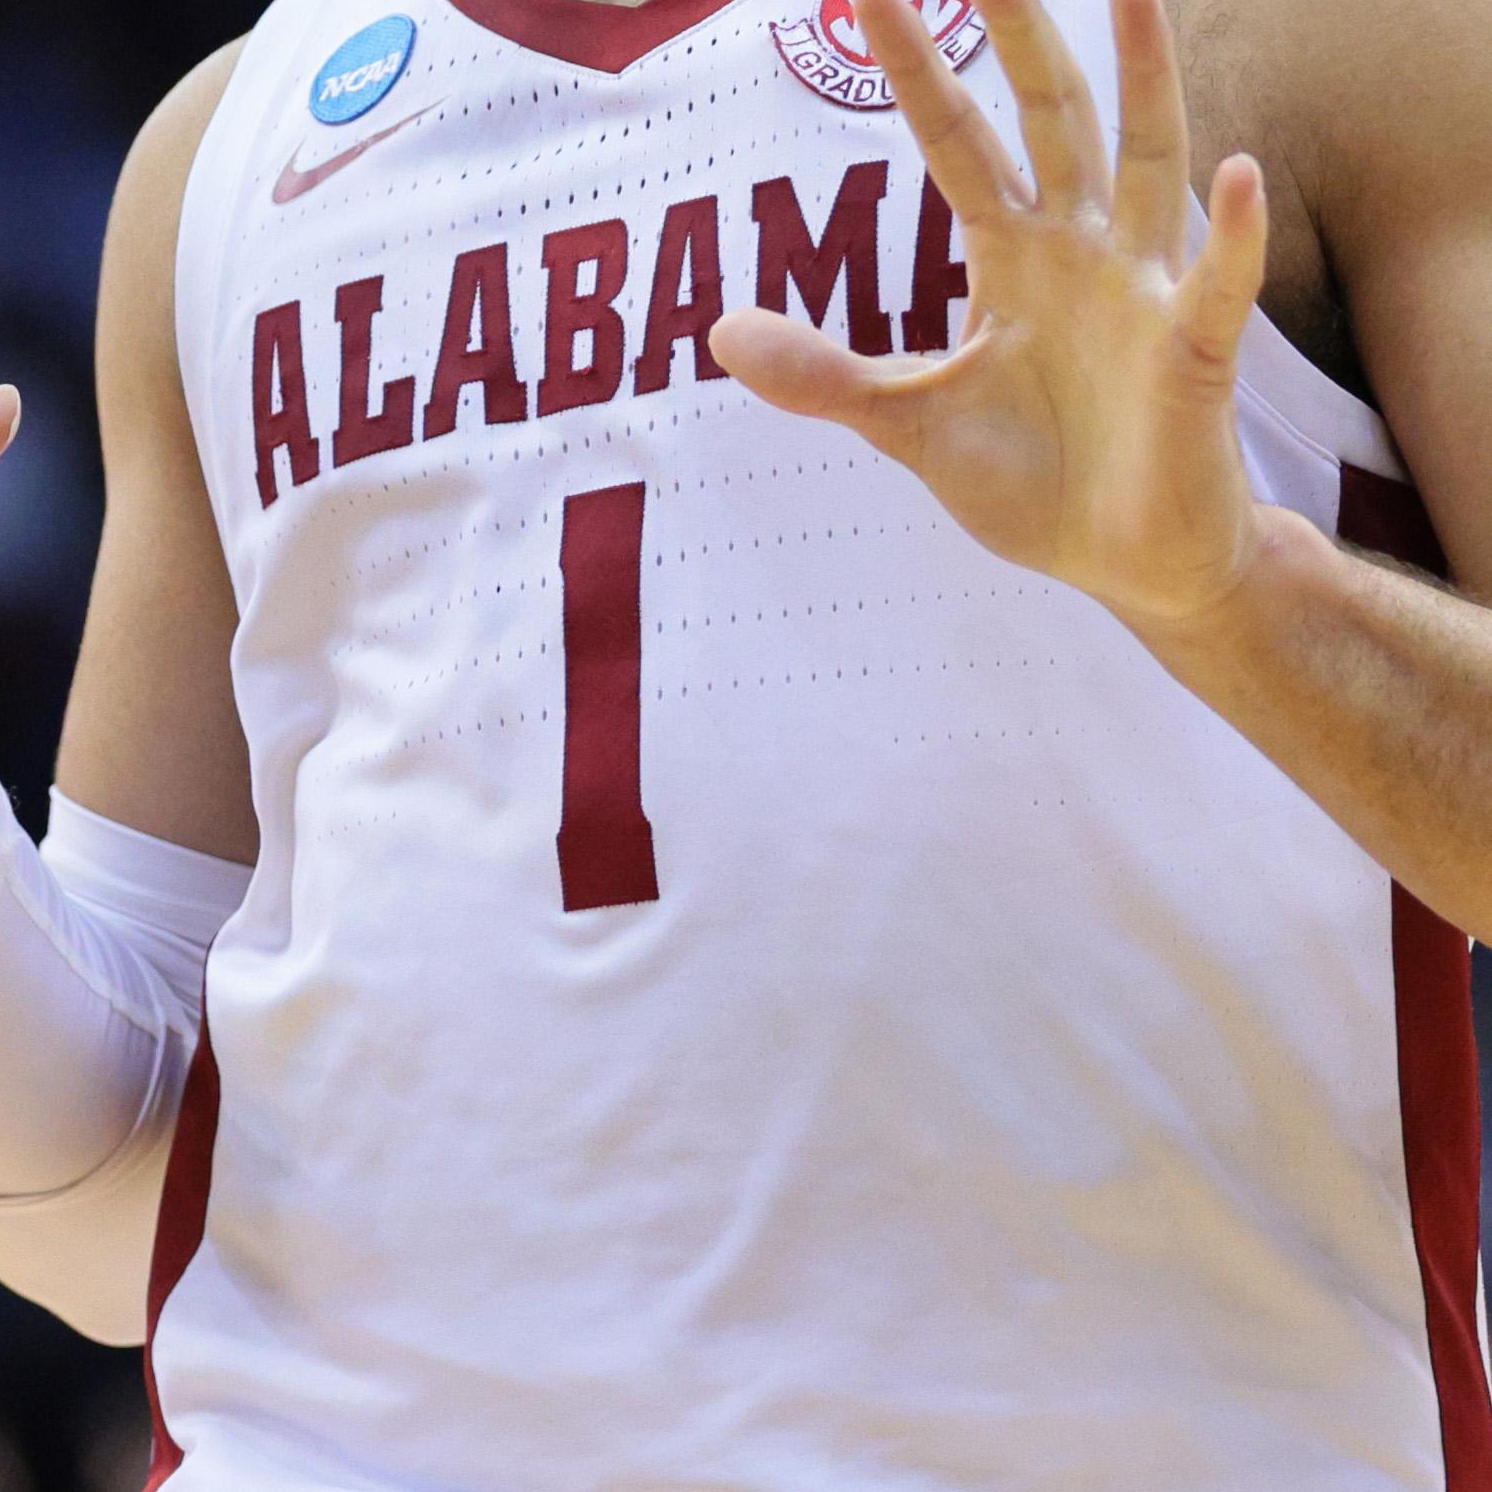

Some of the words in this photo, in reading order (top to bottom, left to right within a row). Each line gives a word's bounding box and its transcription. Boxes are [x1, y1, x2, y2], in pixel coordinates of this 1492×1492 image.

[319, 50, 402, 102] NCAA
[792, 37, 966, 104] GRADUE
[556, 481, 660, 913] 1
